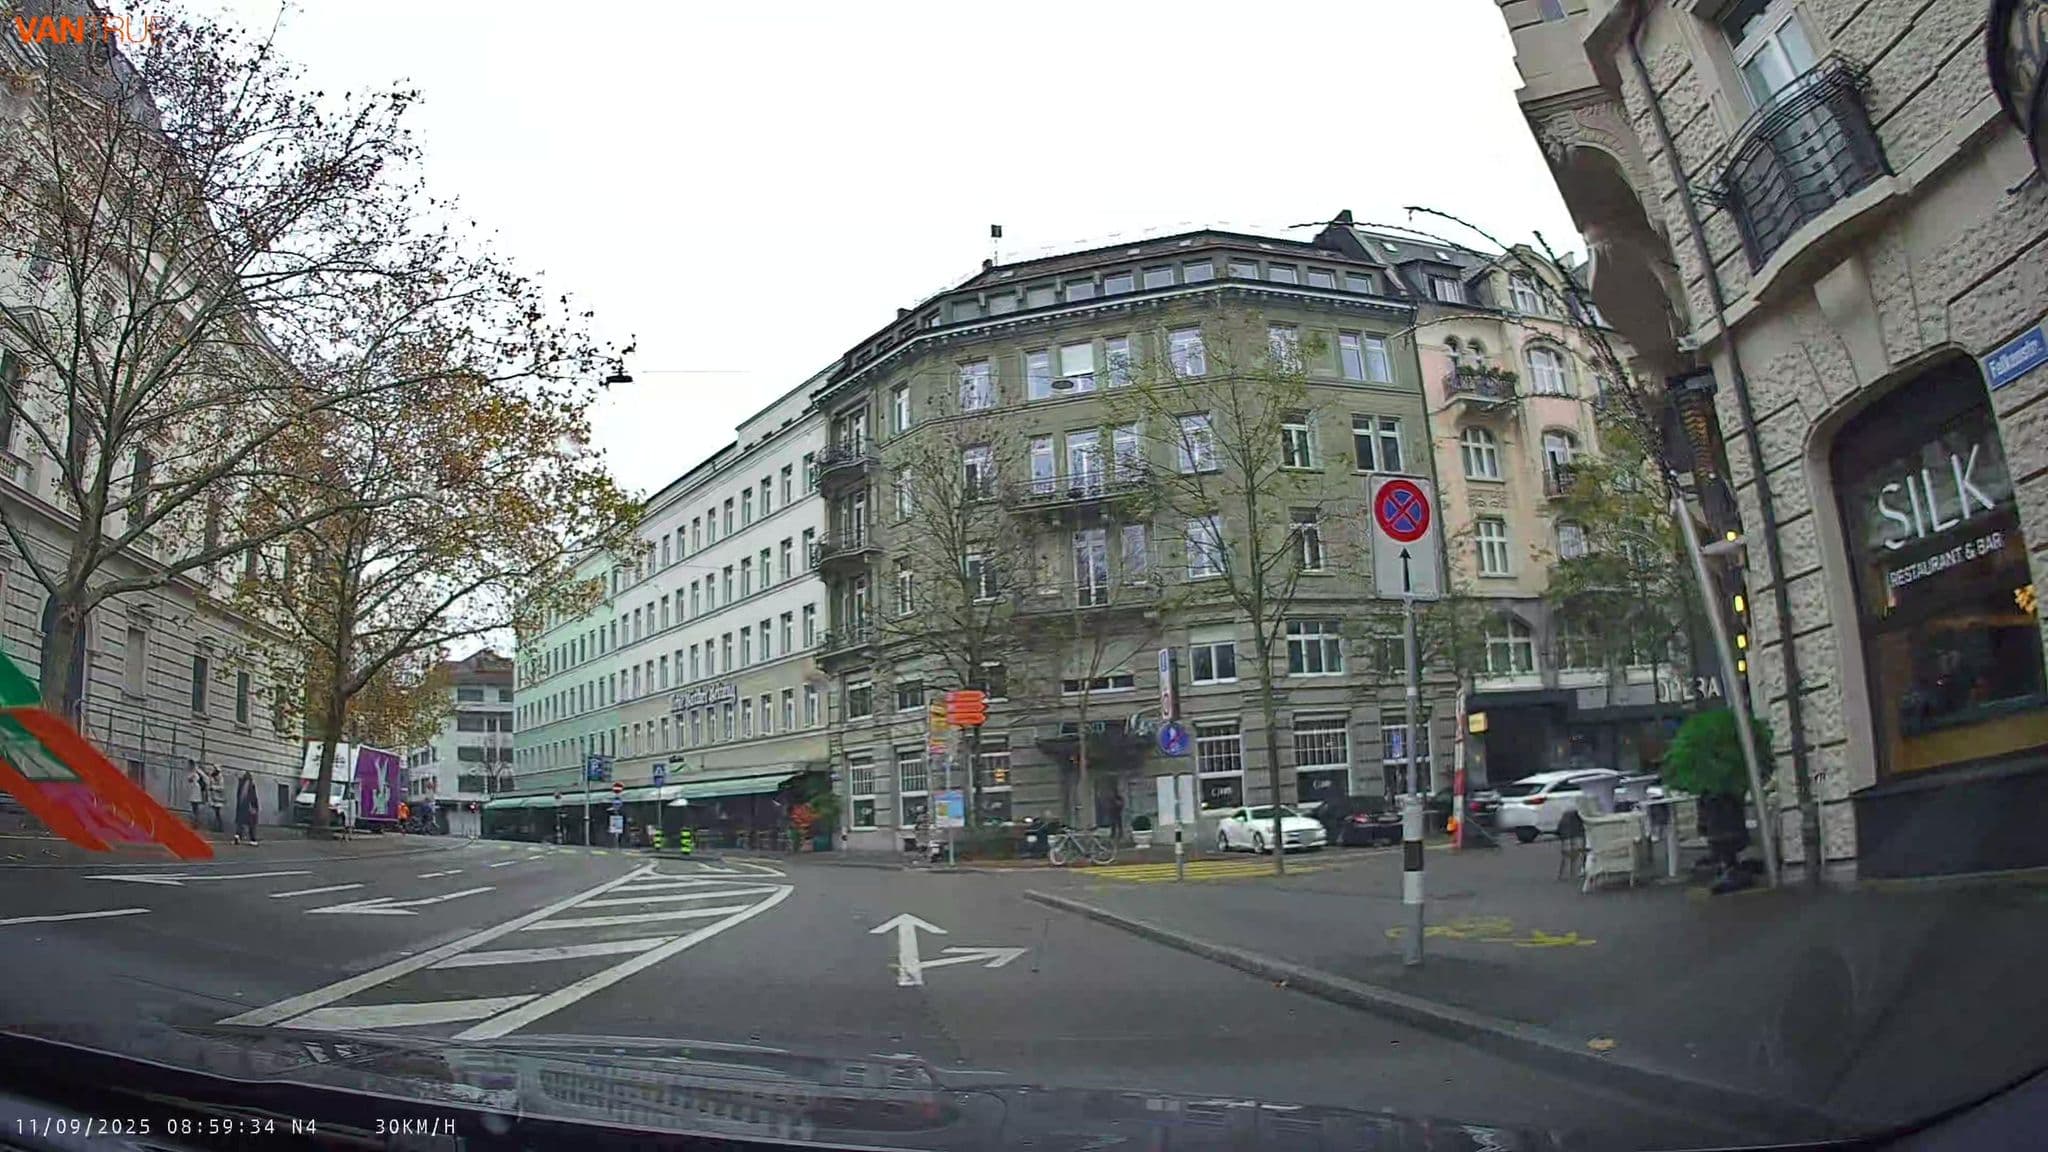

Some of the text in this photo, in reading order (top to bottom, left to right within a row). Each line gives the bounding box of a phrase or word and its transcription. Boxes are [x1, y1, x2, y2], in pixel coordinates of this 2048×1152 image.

[1878, 444, 1994, 550] SILK
[1889, 532, 2003, 587] RESTAURANT & BAR
